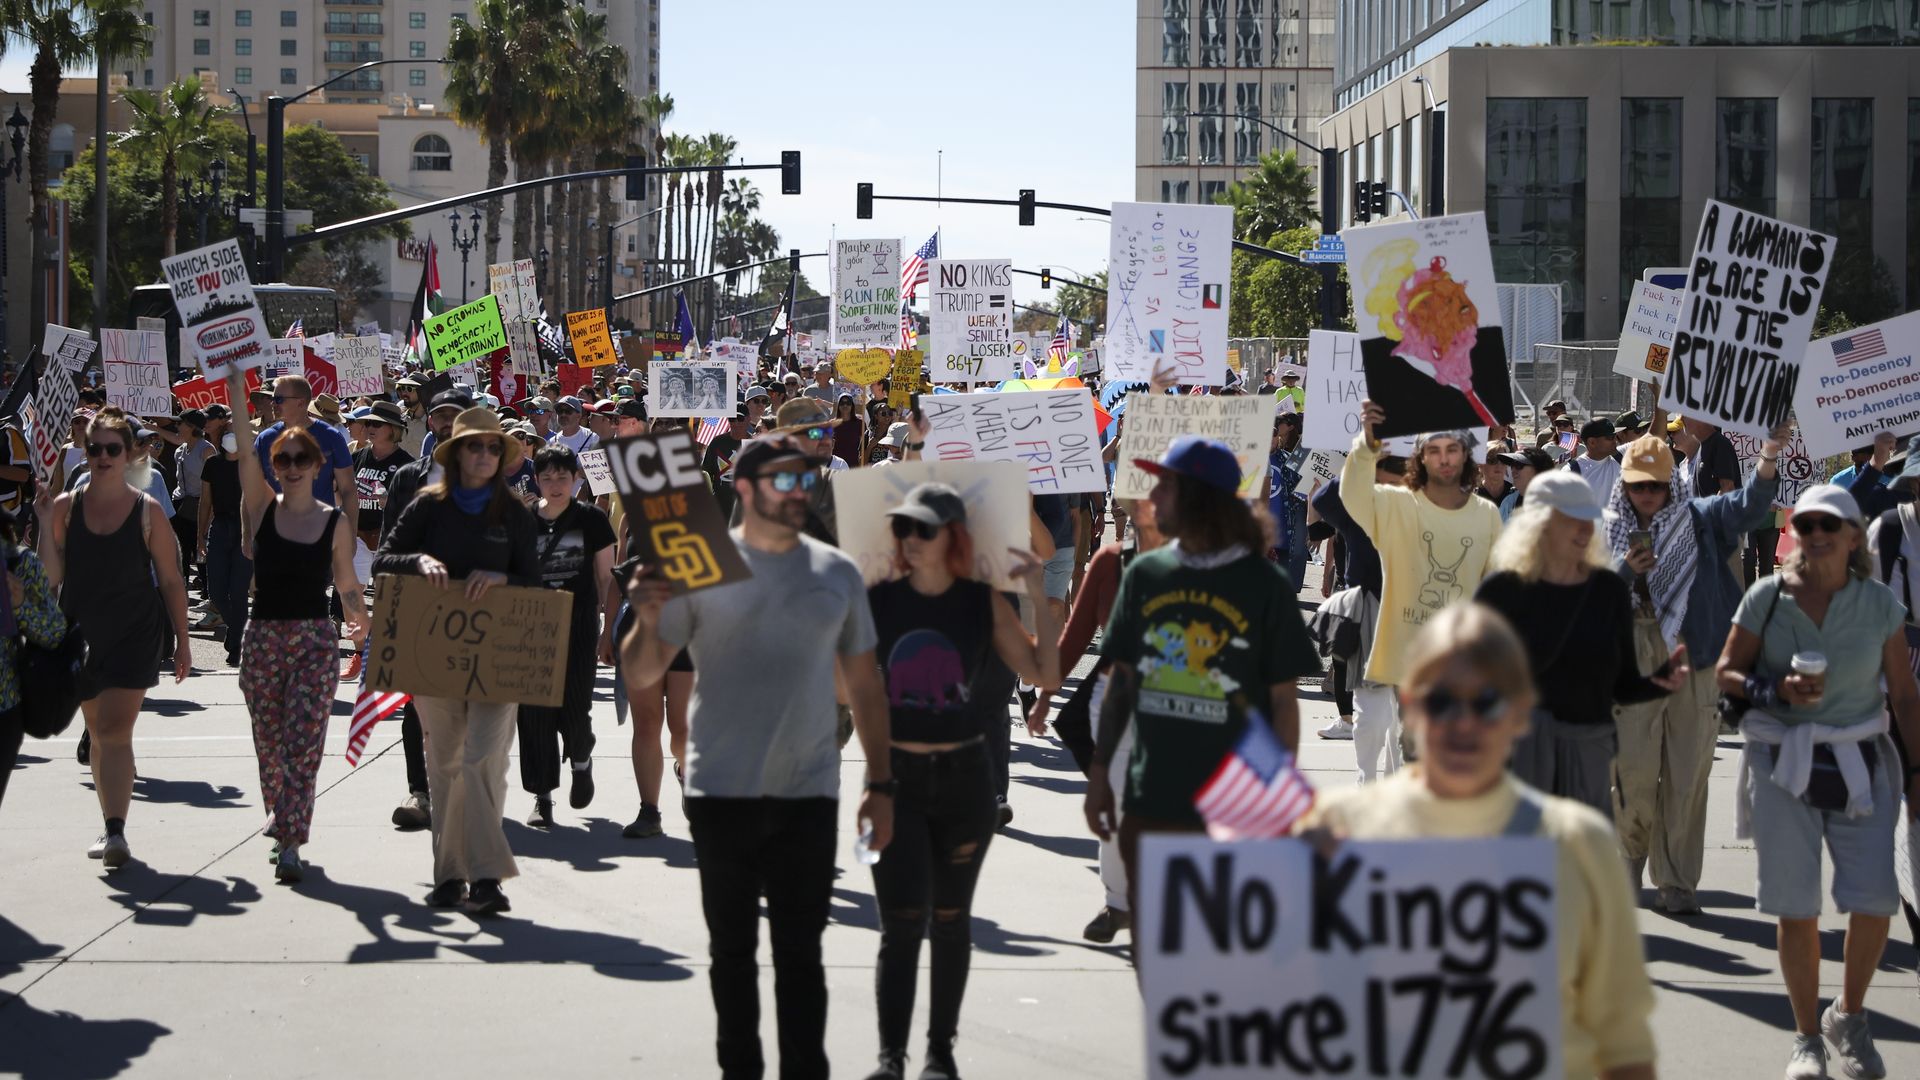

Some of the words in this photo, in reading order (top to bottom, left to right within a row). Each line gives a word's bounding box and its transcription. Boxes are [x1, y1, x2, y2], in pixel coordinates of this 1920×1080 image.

[1698, 204, 1720, 253] A
[839, 241, 871, 258] Maybe
[166, 254, 209, 281] WHICH
[211, 245, 240, 268] SIDE
[846, 257, 864, 270] your
[1176, 228, 1200, 300] CHANGE
[175, 279, 197, 301] ARE
[195, 271, 220, 294] YOU
[222, 264, 245, 286] ON?
[856, 275, 869, 288] to
[940, 264, 967, 288] NO
[971, 264, 1011, 287] KINGS
[1690, 256, 1769, 304] PLACE
[1778, 274, 1820, 316] IS
[844, 288, 873, 304] RUN
[876, 287, 898, 303] FOR
[935, 292, 984, 312] TRUMP
[1642, 287, 1665, 302] Fuck
[429, 323, 445, 340] NO
[446, 302, 486, 327] CROWNS
[840, 303, 898, 318] SOMETHING
[1637, 304, 1659, 319] Fuck
[1690, 295, 1722, 335] IN
[1734, 304, 1789, 349] THE
[200, 327, 229, 346] WORKING
[230, 321, 252, 339] CLASS
[437, 320, 491, 358] DEMOCRACY!
[451, 326, 460, 335] IN
[671, 332, 681, 341] YOU
[966, 329, 1009, 343] SENILE!
[1632, 321, 1654, 336] Fuck
[106, 331, 126, 361] NO
[128, 332, 159, 363] ONE
[335, 345, 379, 361] SATURDAYS
[349, 338, 362, 347] ON
[445, 357, 457, 367] NO
[457, 332, 500, 359] TYRANNY
[970, 343, 1011, 358] LOSER!
[1172, 317, 1206, 379] POLICY
[345, 367, 373, 380] FIGHT
[352, 360, 363, 369] WE
[946, 354, 984, 377] 8647
[1651, 358, 1665, 368] NO
[1820, 355, 1912, 388] Pro-Decency
[50, 352, 79, 409] WHICH
[106, 364, 118, 383] IS
[124, 363, 167, 388] ILLEGAL
[339, 374, 384, 396] FASCISM
[42, 374, 71, 431] SIDE
[128, 386, 144, 398] ON
[1008, 403, 1042, 431] IS
[1047, 393, 1083, 423] NO
[1129, 397, 1157, 413] THE
[1164, 398, 1213, 416] ENEMY
[1219, 399, 1259, 414] WITHIN
[972, 397, 1009, 452] WHEN
[1129, 418, 1142, 432] IS
[1149, 418, 1163, 433] IN
[1170, 418, 1191, 433] THE
[1200, 418, 1241, 434] WHITE
[607, 433, 705, 494] ICE
[1058, 433, 1094, 479] ONE
[1311, 452, 1330, 468] FREE
[357, 467, 388, 481] GIRLS
[1159, 852, 1277, 955] No
[1309, 852, 1554, 976] Kings
[1365, 975, 1549, 1080] 1776
